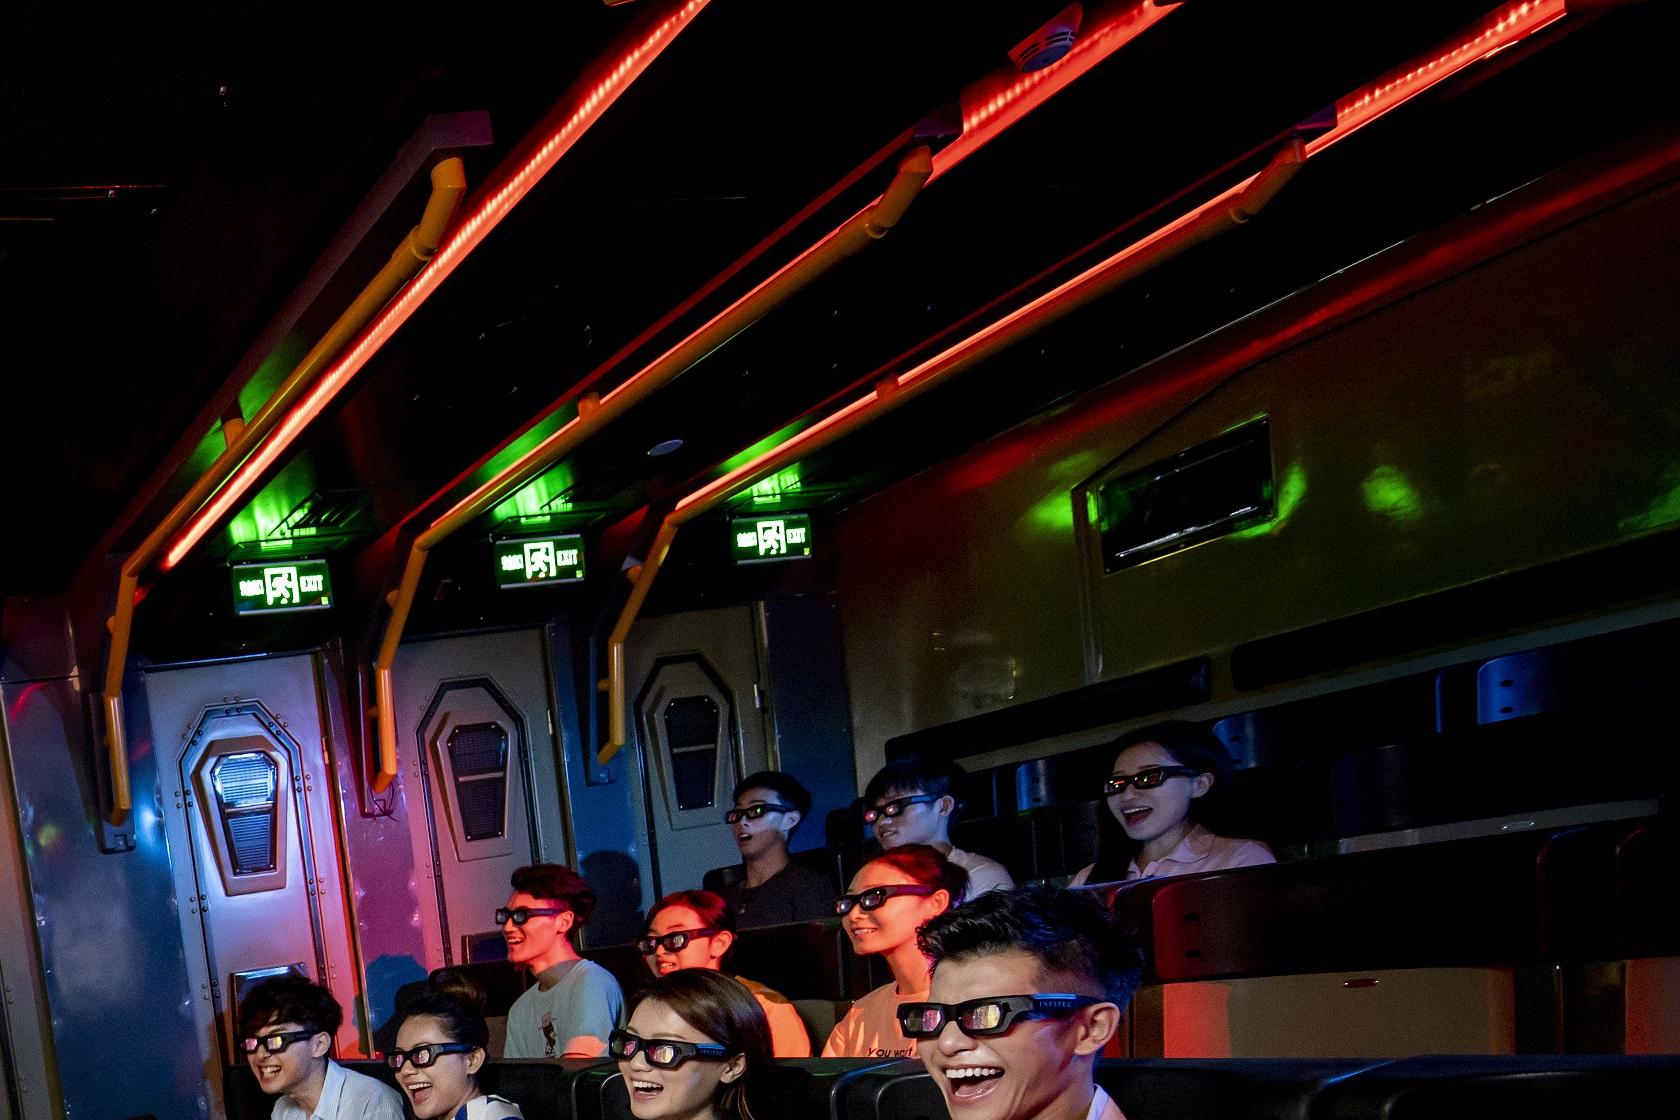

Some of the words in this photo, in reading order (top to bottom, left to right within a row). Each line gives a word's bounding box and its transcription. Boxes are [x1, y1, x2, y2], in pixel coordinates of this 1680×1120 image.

[786, 527, 806, 544] EXIT
[556, 549, 578, 567] EXIT
[299, 574, 324, 592] EXIT
